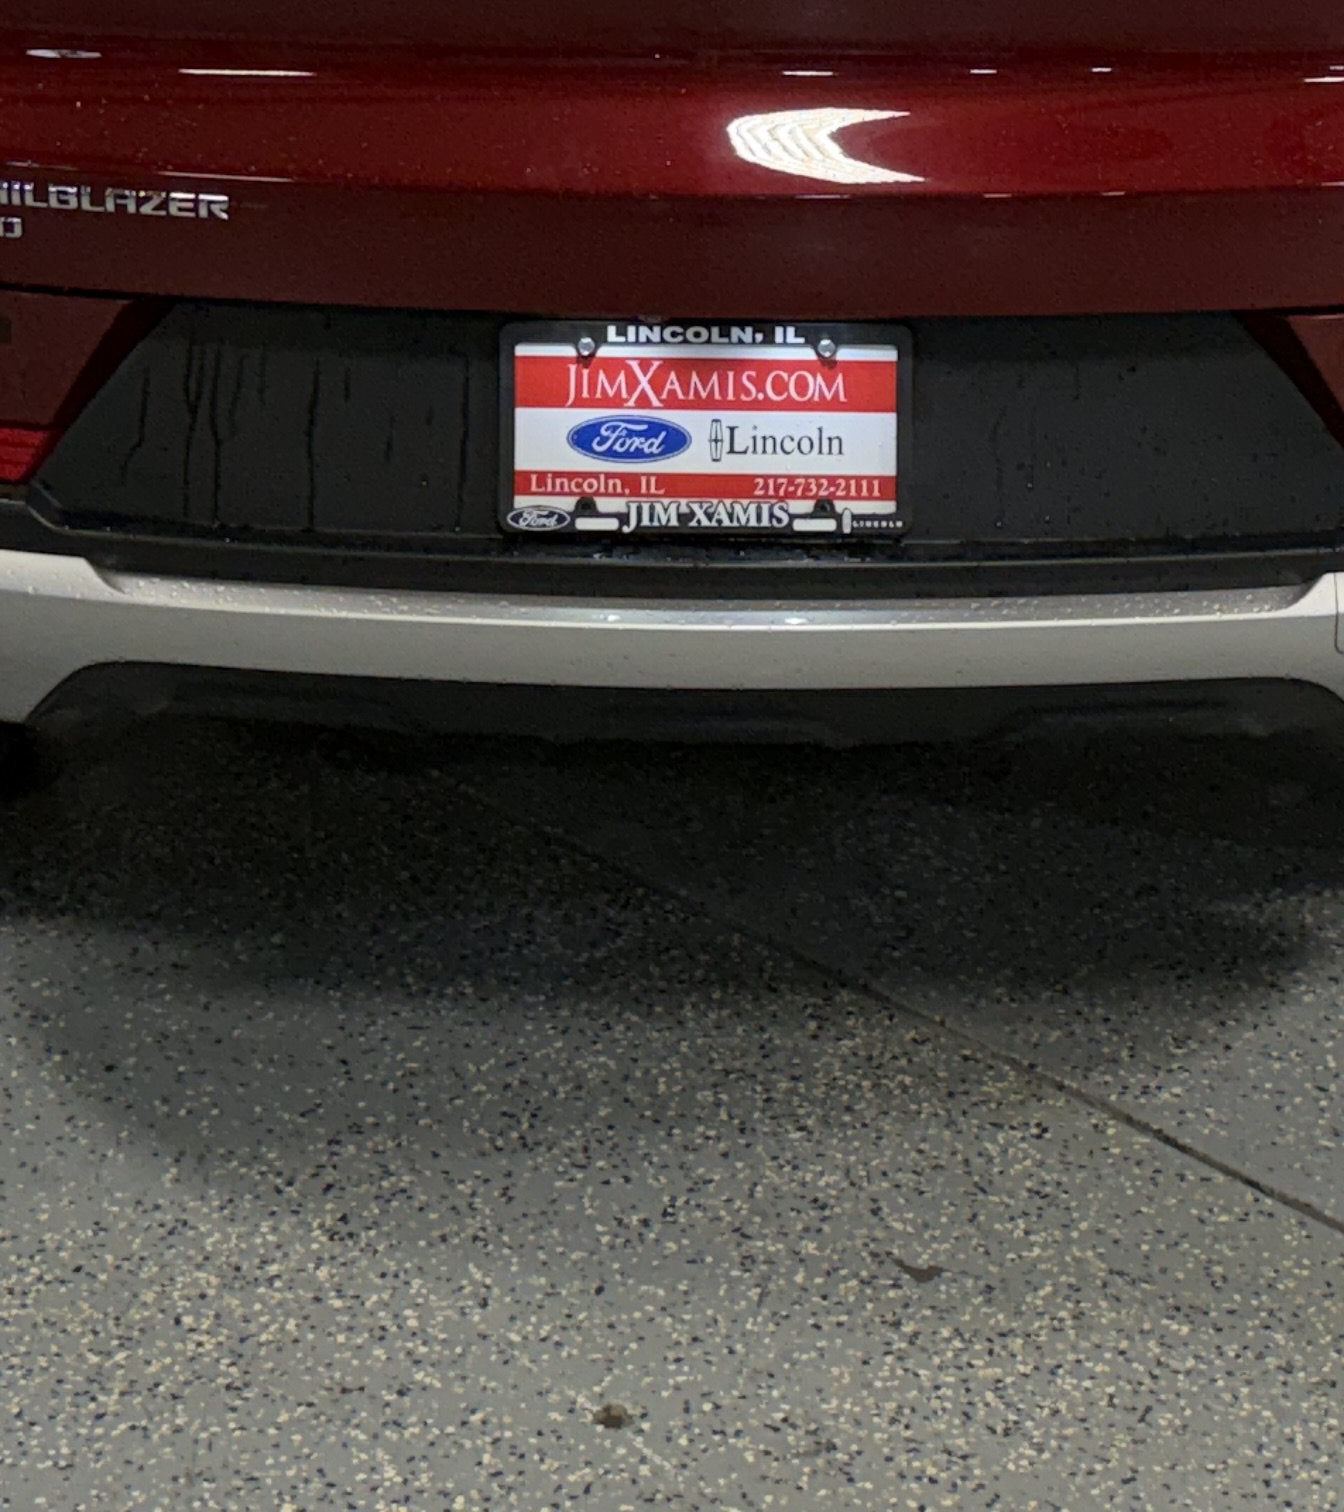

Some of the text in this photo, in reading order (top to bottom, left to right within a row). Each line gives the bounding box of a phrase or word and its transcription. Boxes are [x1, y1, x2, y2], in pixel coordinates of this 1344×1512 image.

[607, 325, 806, 345] LINCOLN, IL
[565, 359, 848, 407] JIMXAMIS.COM
[592, 421, 666, 455] Ford
[725, 425, 844, 456] Lincoln
[530, 473, 666, 495] Lincoln, IL
[753, 477, 882, 497] 217-732-2111
[519, 510, 559, 528] Ford
[622, 500, 790, 533] JIM XAMIS
